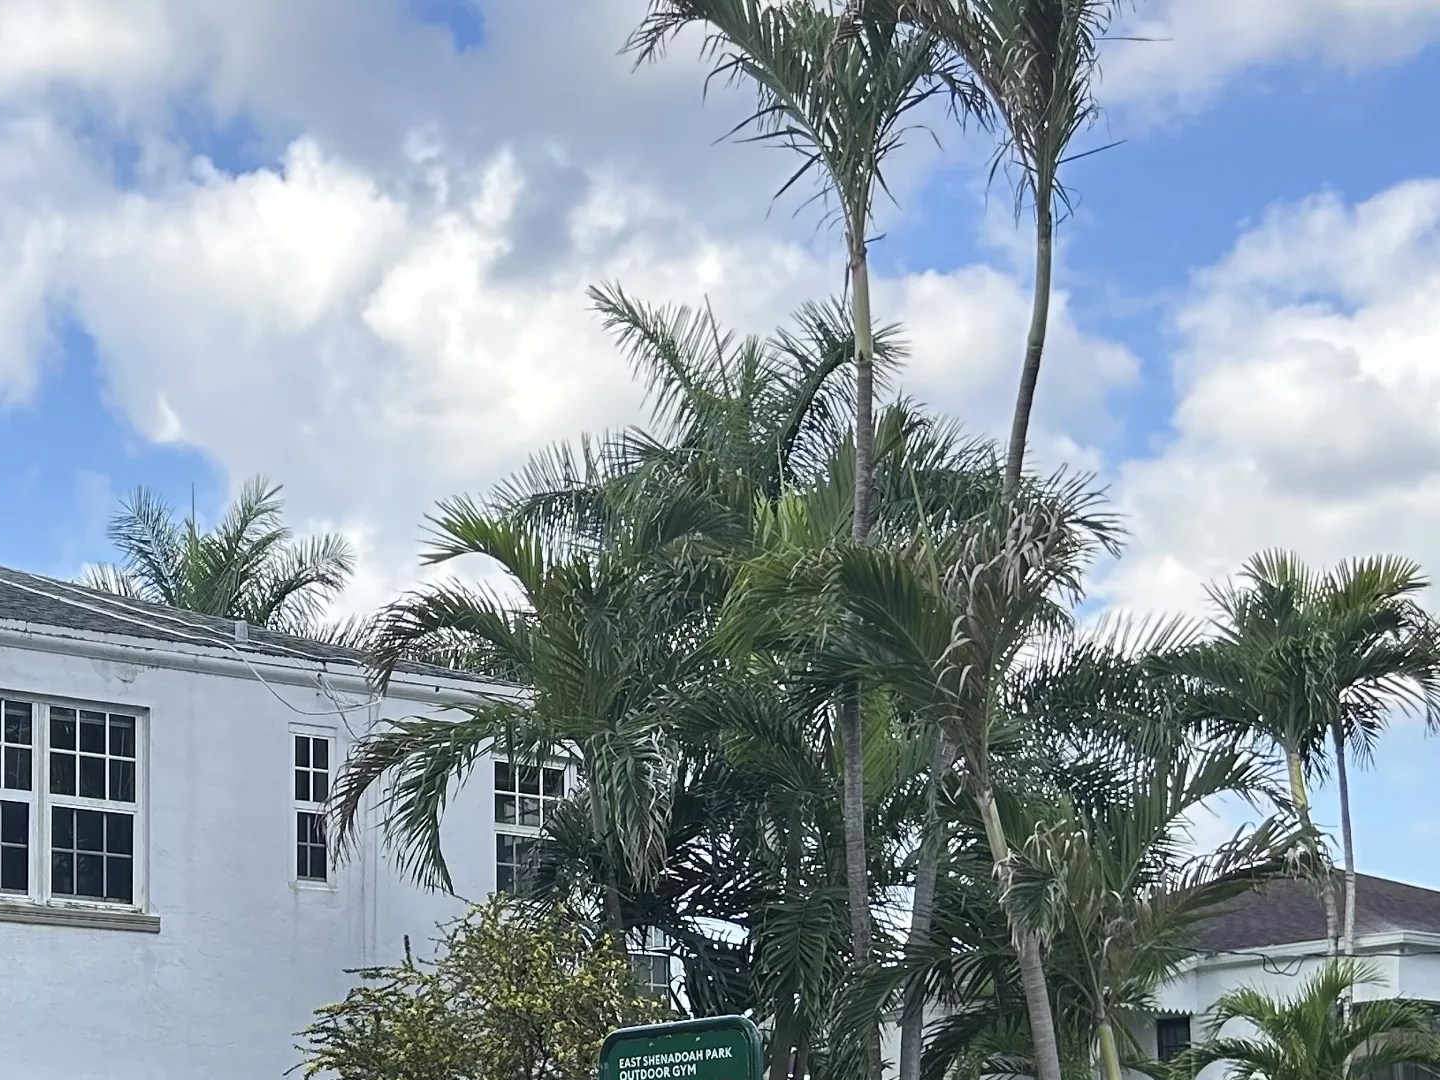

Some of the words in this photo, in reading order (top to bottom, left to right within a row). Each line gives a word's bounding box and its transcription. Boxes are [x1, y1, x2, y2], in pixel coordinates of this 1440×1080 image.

[619, 1057, 641, 1069] EAST
[643, 1050, 703, 1067] SHENADOAH
[705, 1046, 732, 1060] PARK
[672, 1064, 697, 1077] GYM
